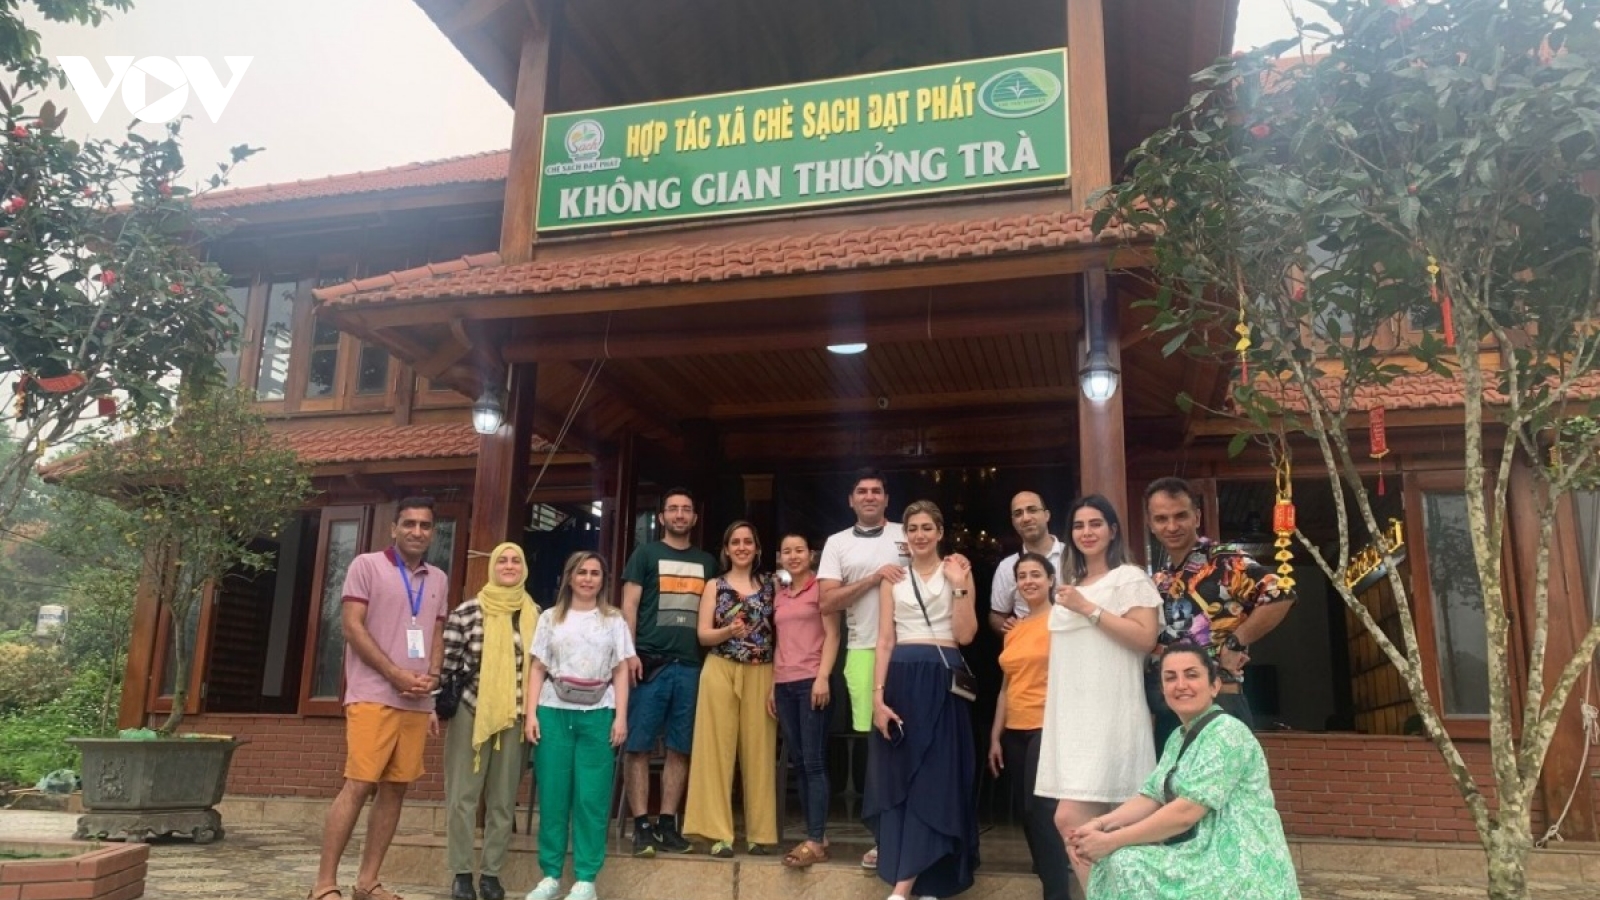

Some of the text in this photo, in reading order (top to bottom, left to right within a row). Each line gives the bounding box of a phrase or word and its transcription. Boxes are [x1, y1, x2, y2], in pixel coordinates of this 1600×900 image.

[626, 76, 976, 162] HỢP TÁC XÃ CHÈ SẠCH ĐẠT PHÁT
[559, 130, 1041, 219] KHÔNG GIAN THƯỞNG TRÀ
